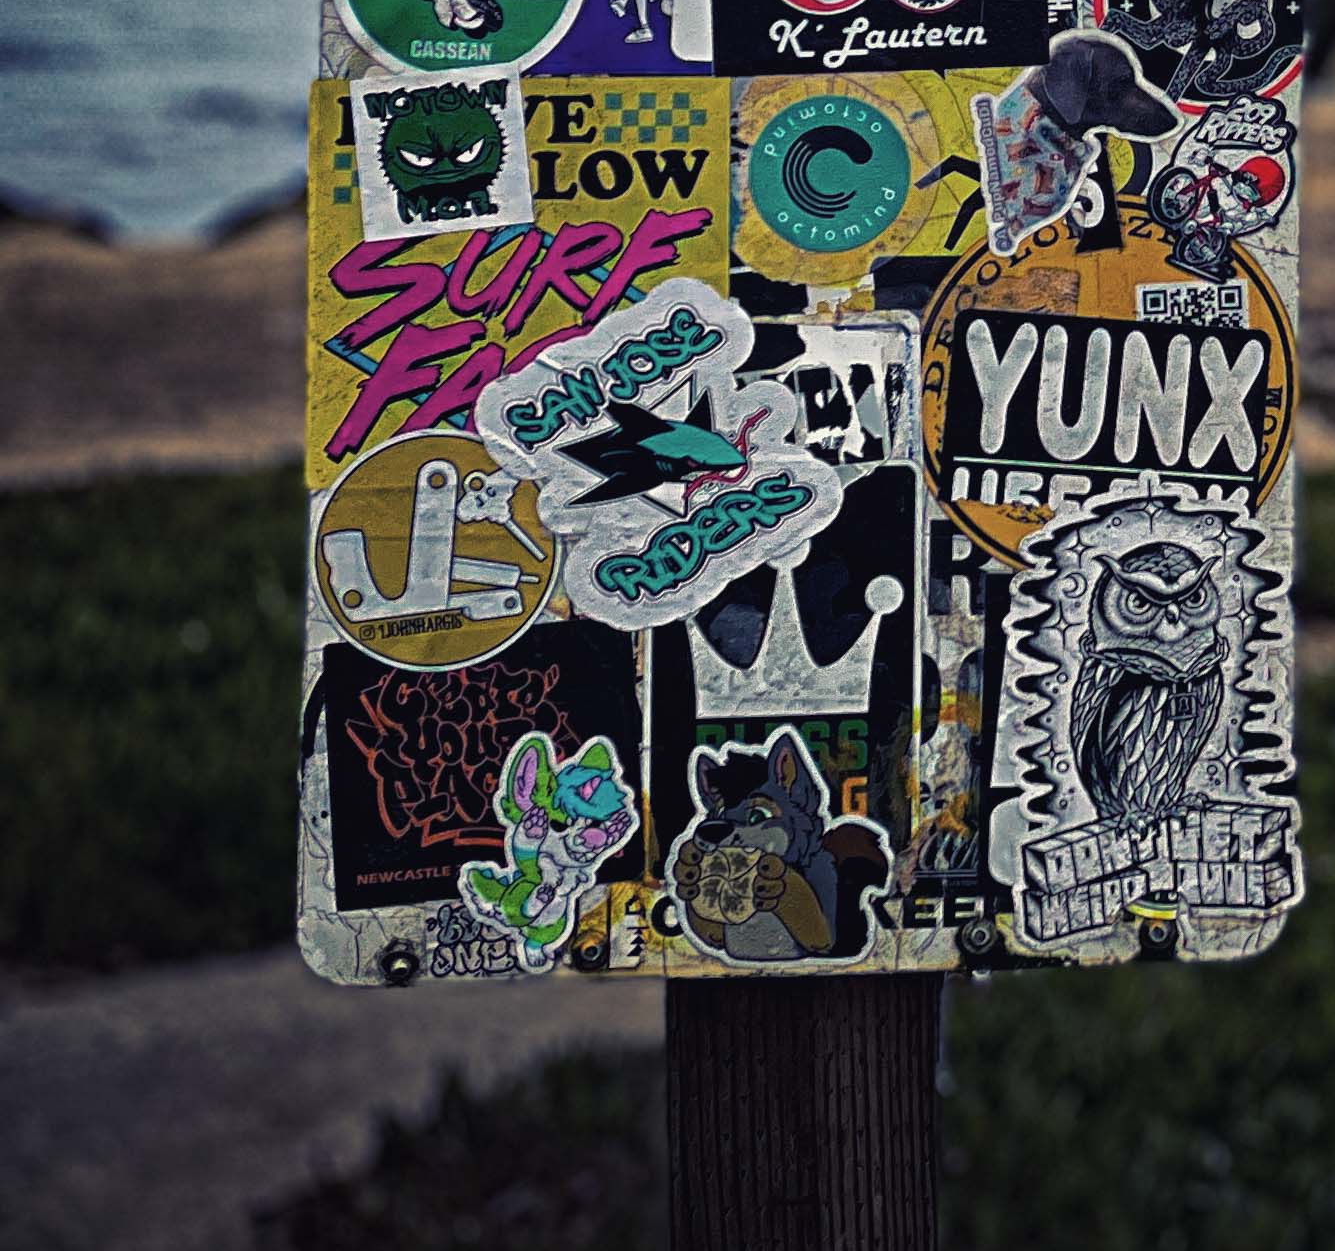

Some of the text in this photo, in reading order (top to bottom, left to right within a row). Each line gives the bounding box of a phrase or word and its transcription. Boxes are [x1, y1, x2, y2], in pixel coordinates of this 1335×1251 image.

[410, 39, 492, 62] CASSEAN
[823, 17, 988, 68] Lautern
[364, 79, 509, 120] NOTOWN
[1227, 98, 1277, 125] 209
[1197, 111, 1287, 151] RIPPERS
[777, 187, 896, 241] octomind
[327, 208, 712, 353] SURF
[505, 306, 724, 449] SAN JOSE
[965, 319, 1265, 472] YUNX
[597, 473, 812, 601] RIDERS
[356, 865, 452, 886] NEWCASTLE
